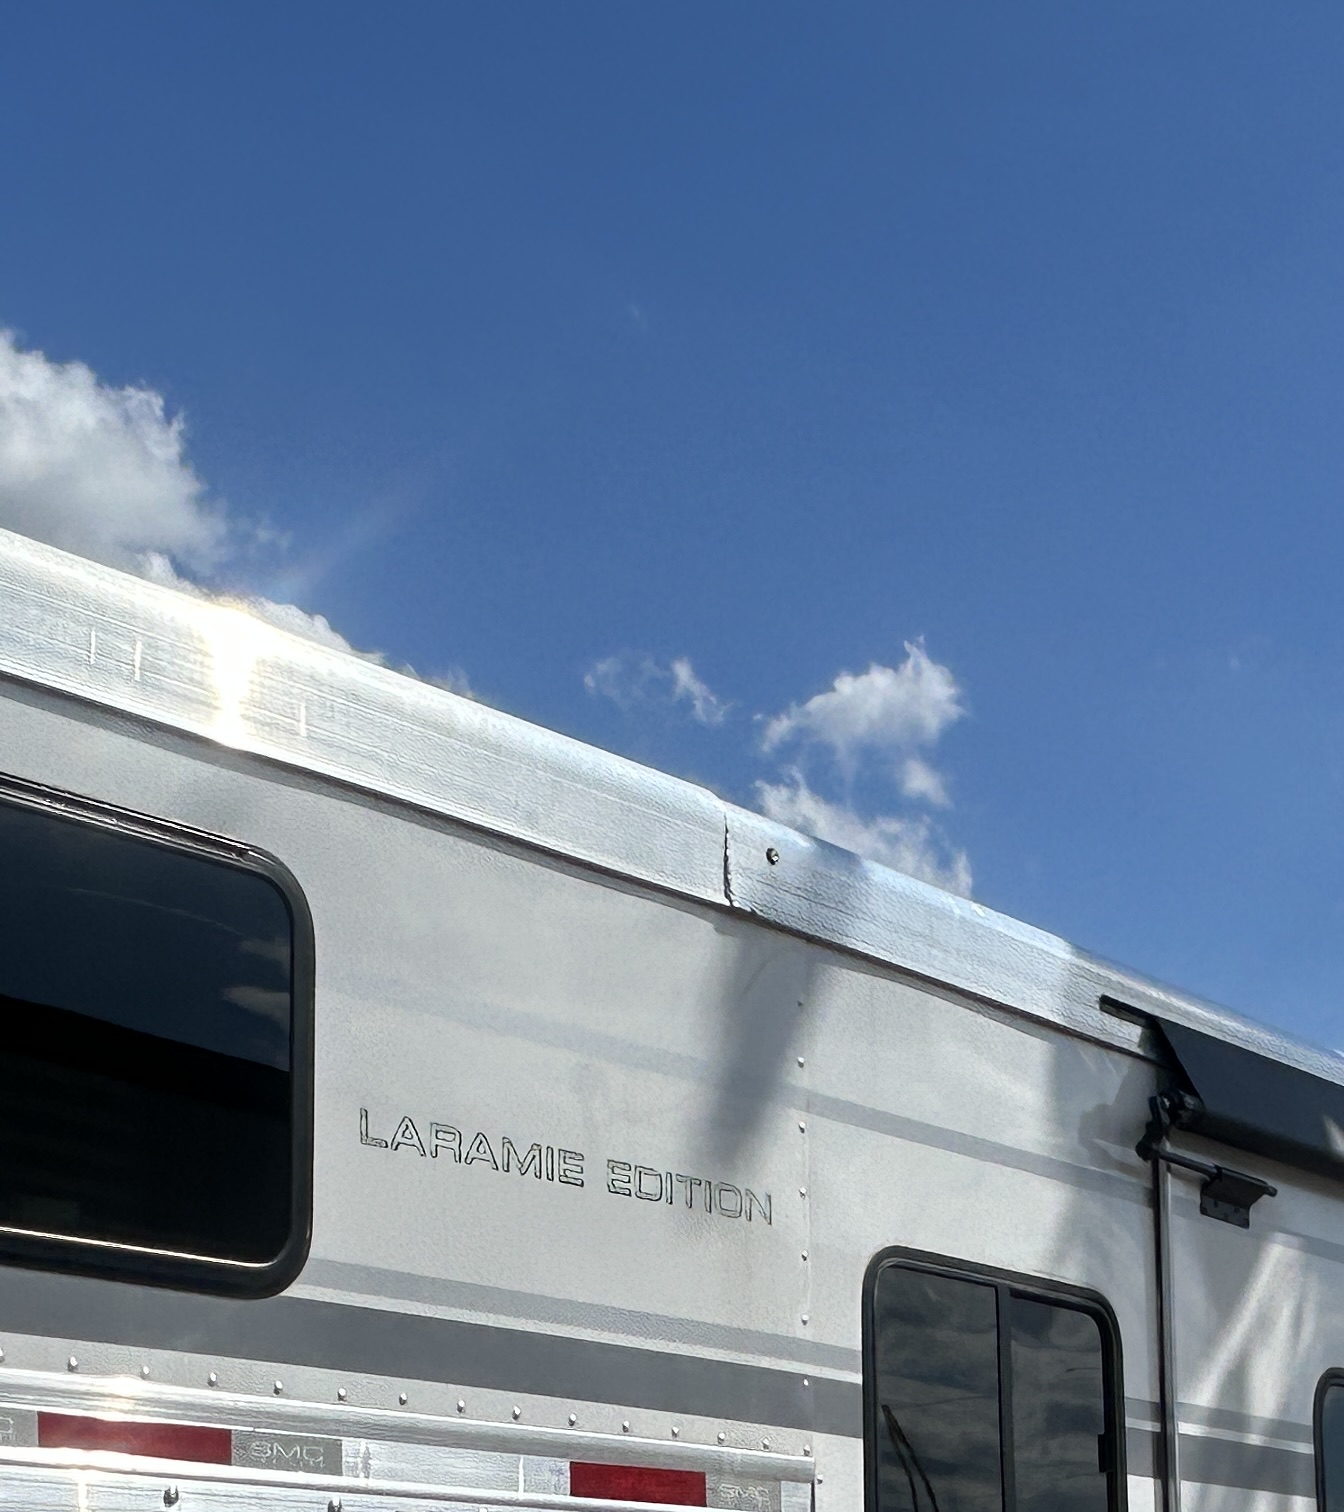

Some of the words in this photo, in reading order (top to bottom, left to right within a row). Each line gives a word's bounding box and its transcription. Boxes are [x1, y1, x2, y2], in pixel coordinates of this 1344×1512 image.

[359, 1107, 585, 1187] LARAMIE
[606, 1159, 772, 1226] EDITION
[249, 1440, 324, 1462] SMC
